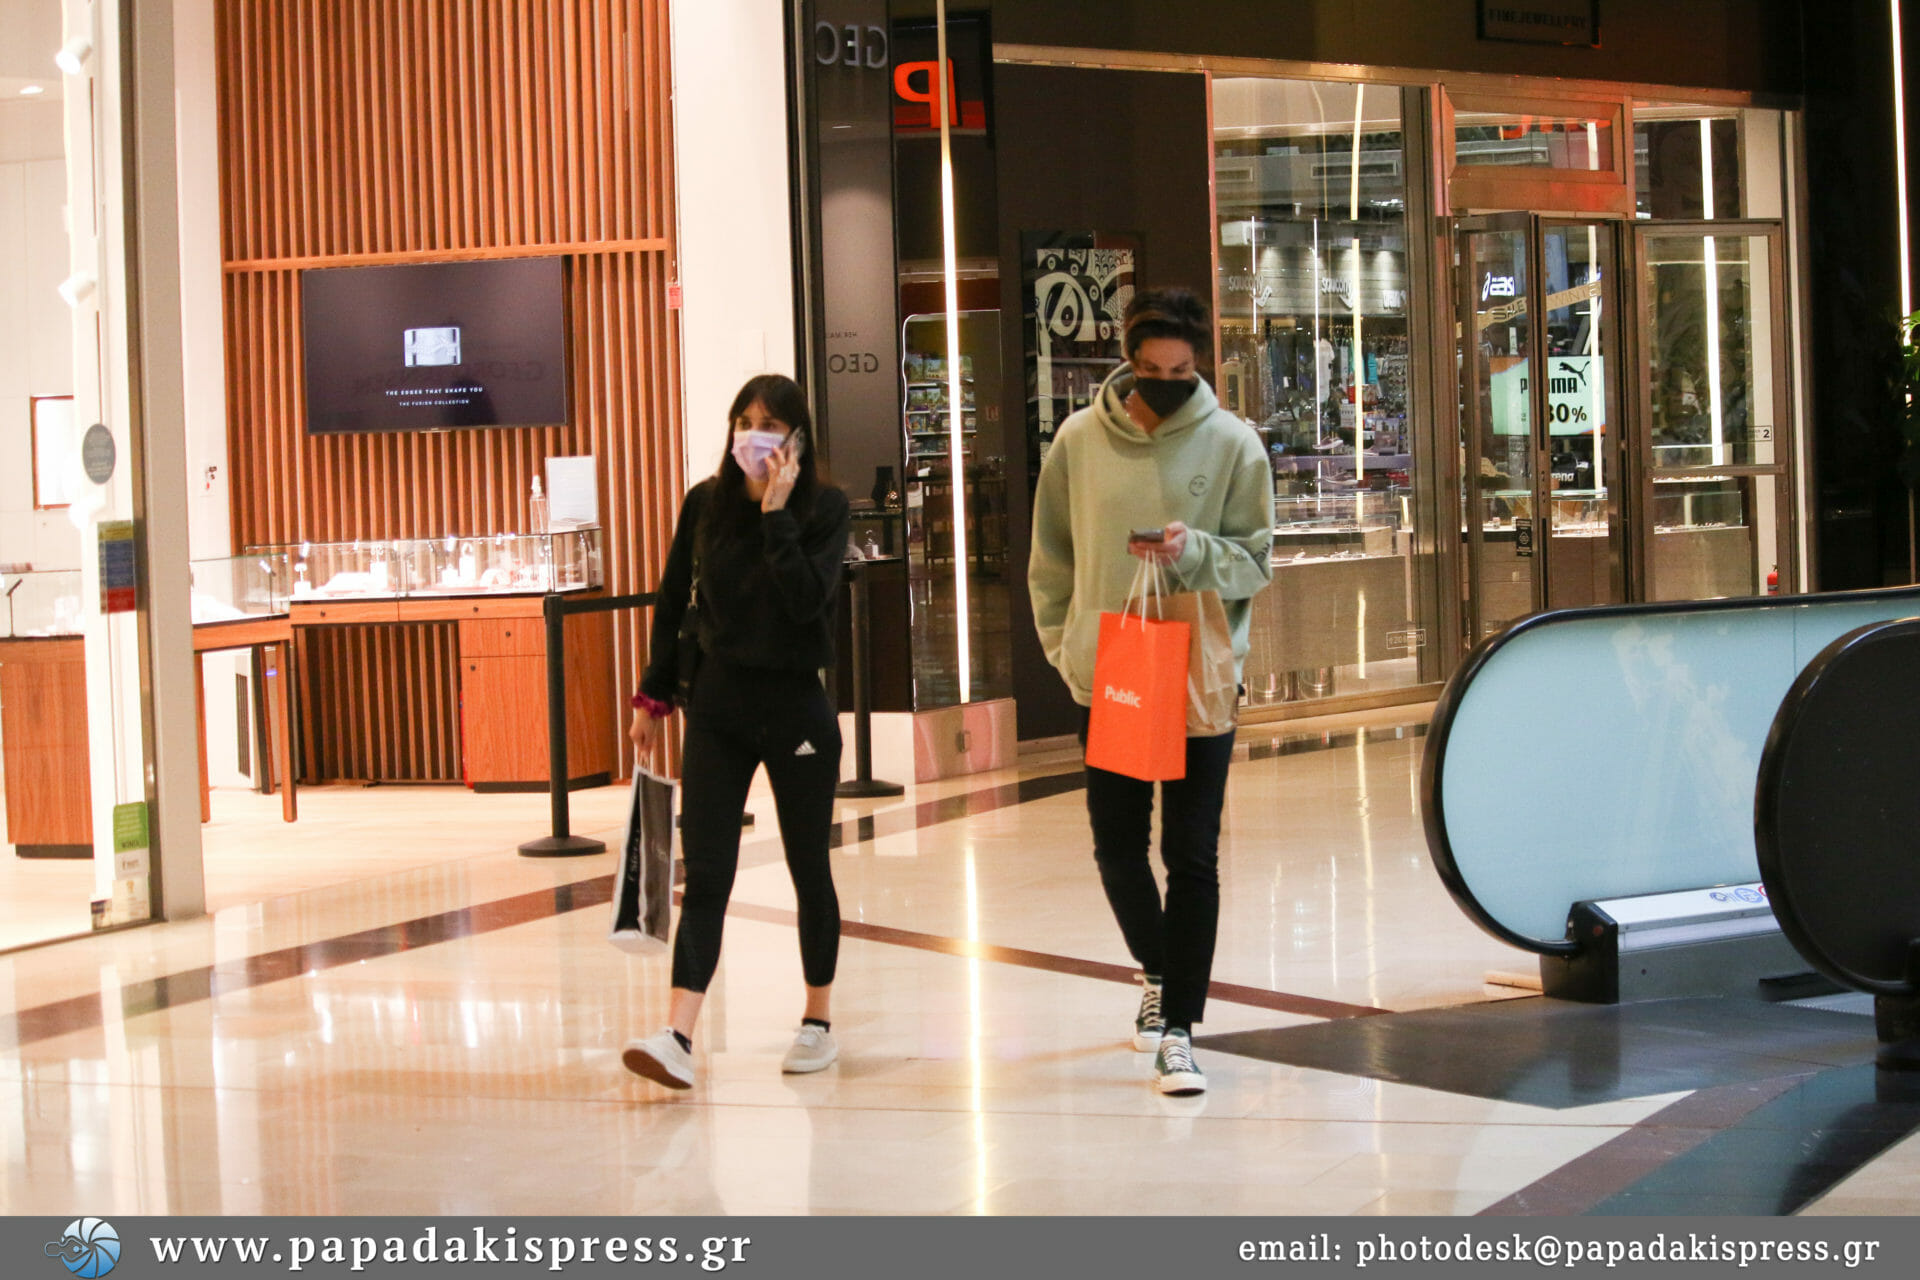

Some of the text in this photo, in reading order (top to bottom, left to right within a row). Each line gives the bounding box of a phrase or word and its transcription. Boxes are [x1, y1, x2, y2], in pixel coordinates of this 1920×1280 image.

[1520, 377, 1578, 394] PMA
[1762, 429, 1770, 439] 2
[1104, 685, 1141, 708] Public
